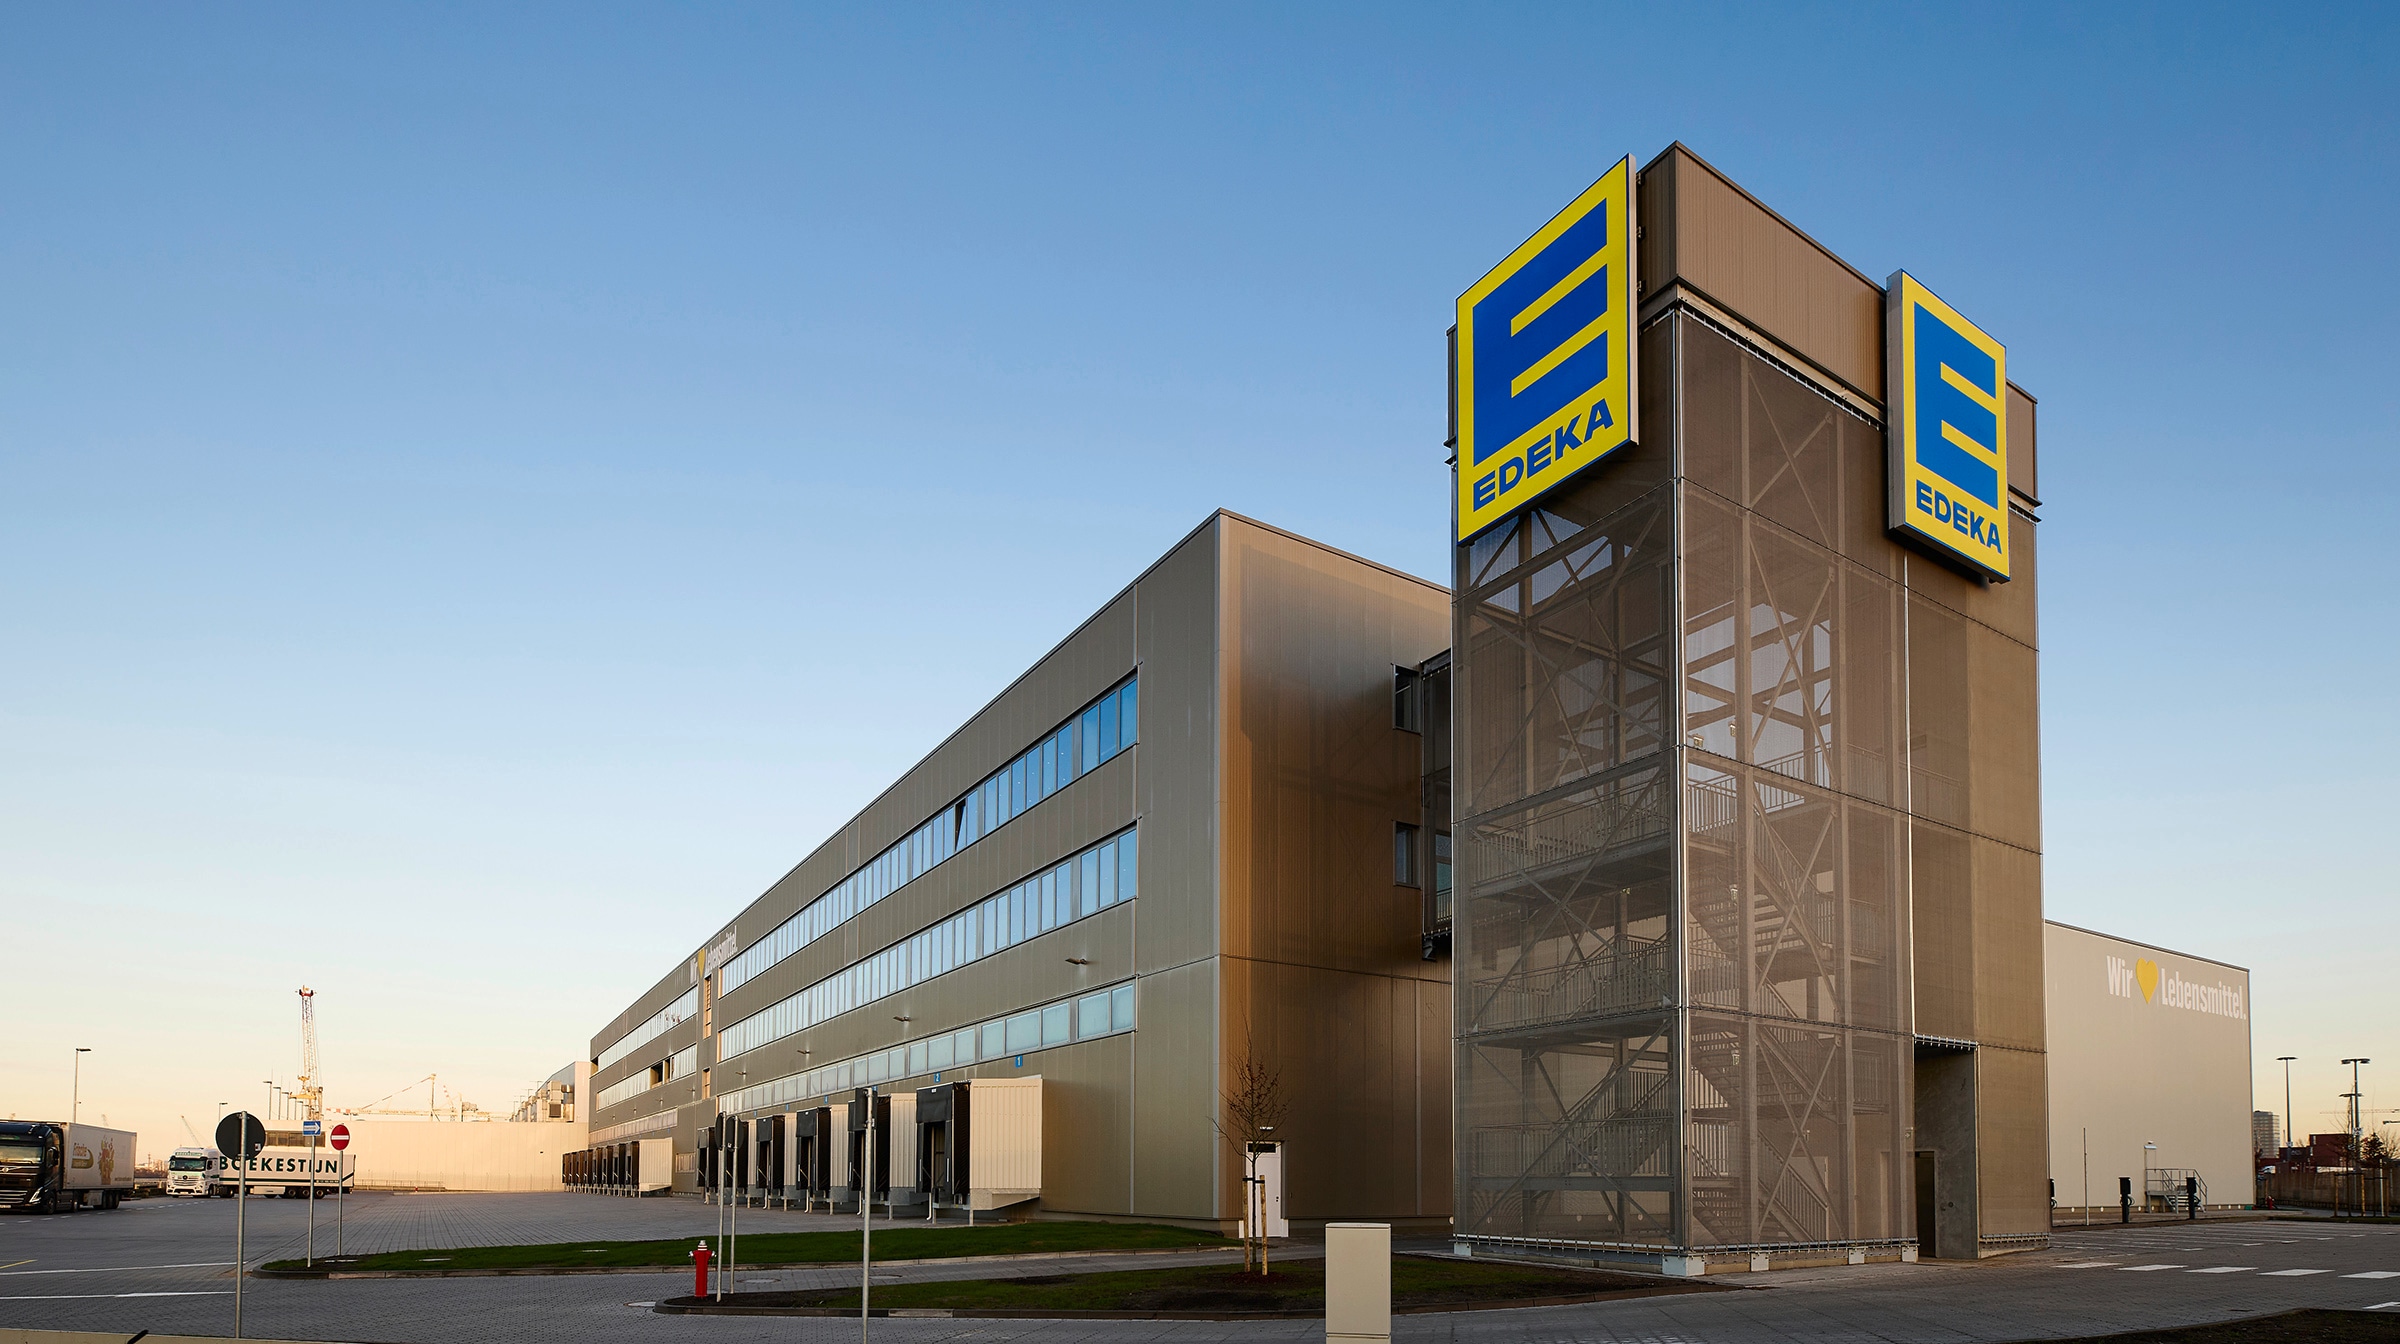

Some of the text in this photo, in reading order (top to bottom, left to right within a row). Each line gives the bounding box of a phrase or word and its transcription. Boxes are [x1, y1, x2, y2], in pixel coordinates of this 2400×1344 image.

[1472, 197, 1608, 467] E
[1913, 300, 1999, 511] E
[1473, 397, 1614, 512] EDEKA
[1915, 479, 2003, 555] EDEKA
[2106, 955, 2247, 1020] Wir Lebensmittel.
[219, 1156, 338, 1173] BOEKESTIJN
